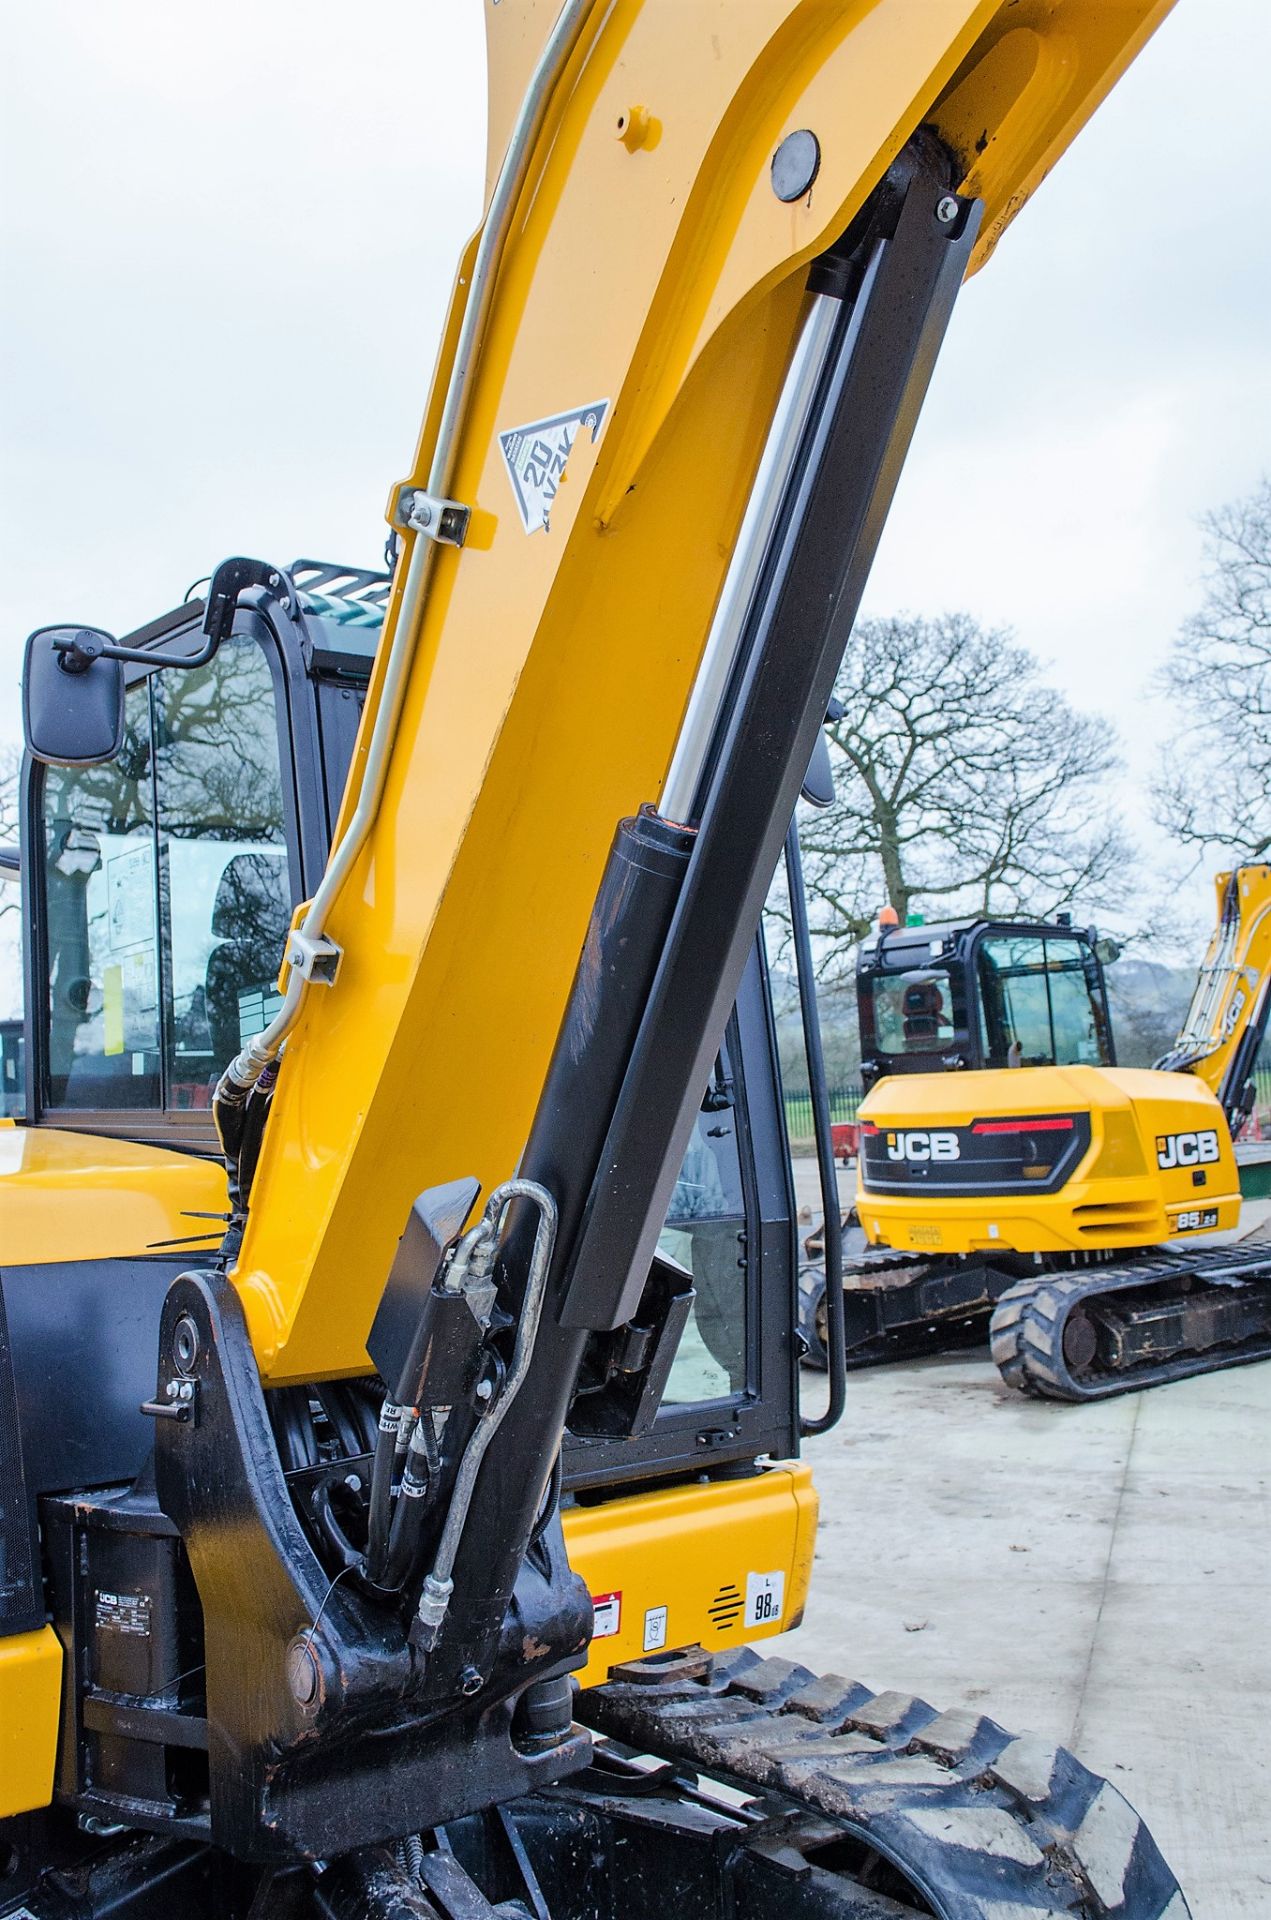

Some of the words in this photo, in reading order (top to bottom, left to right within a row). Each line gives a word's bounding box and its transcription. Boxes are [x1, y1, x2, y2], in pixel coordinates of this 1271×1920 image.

[887, 1132, 960, 1161] JCB
[1157, 1131, 1219, 1168] JCB
[1178, 1212, 1200, 1228] 85
[755, 1593, 772, 1620] 98
